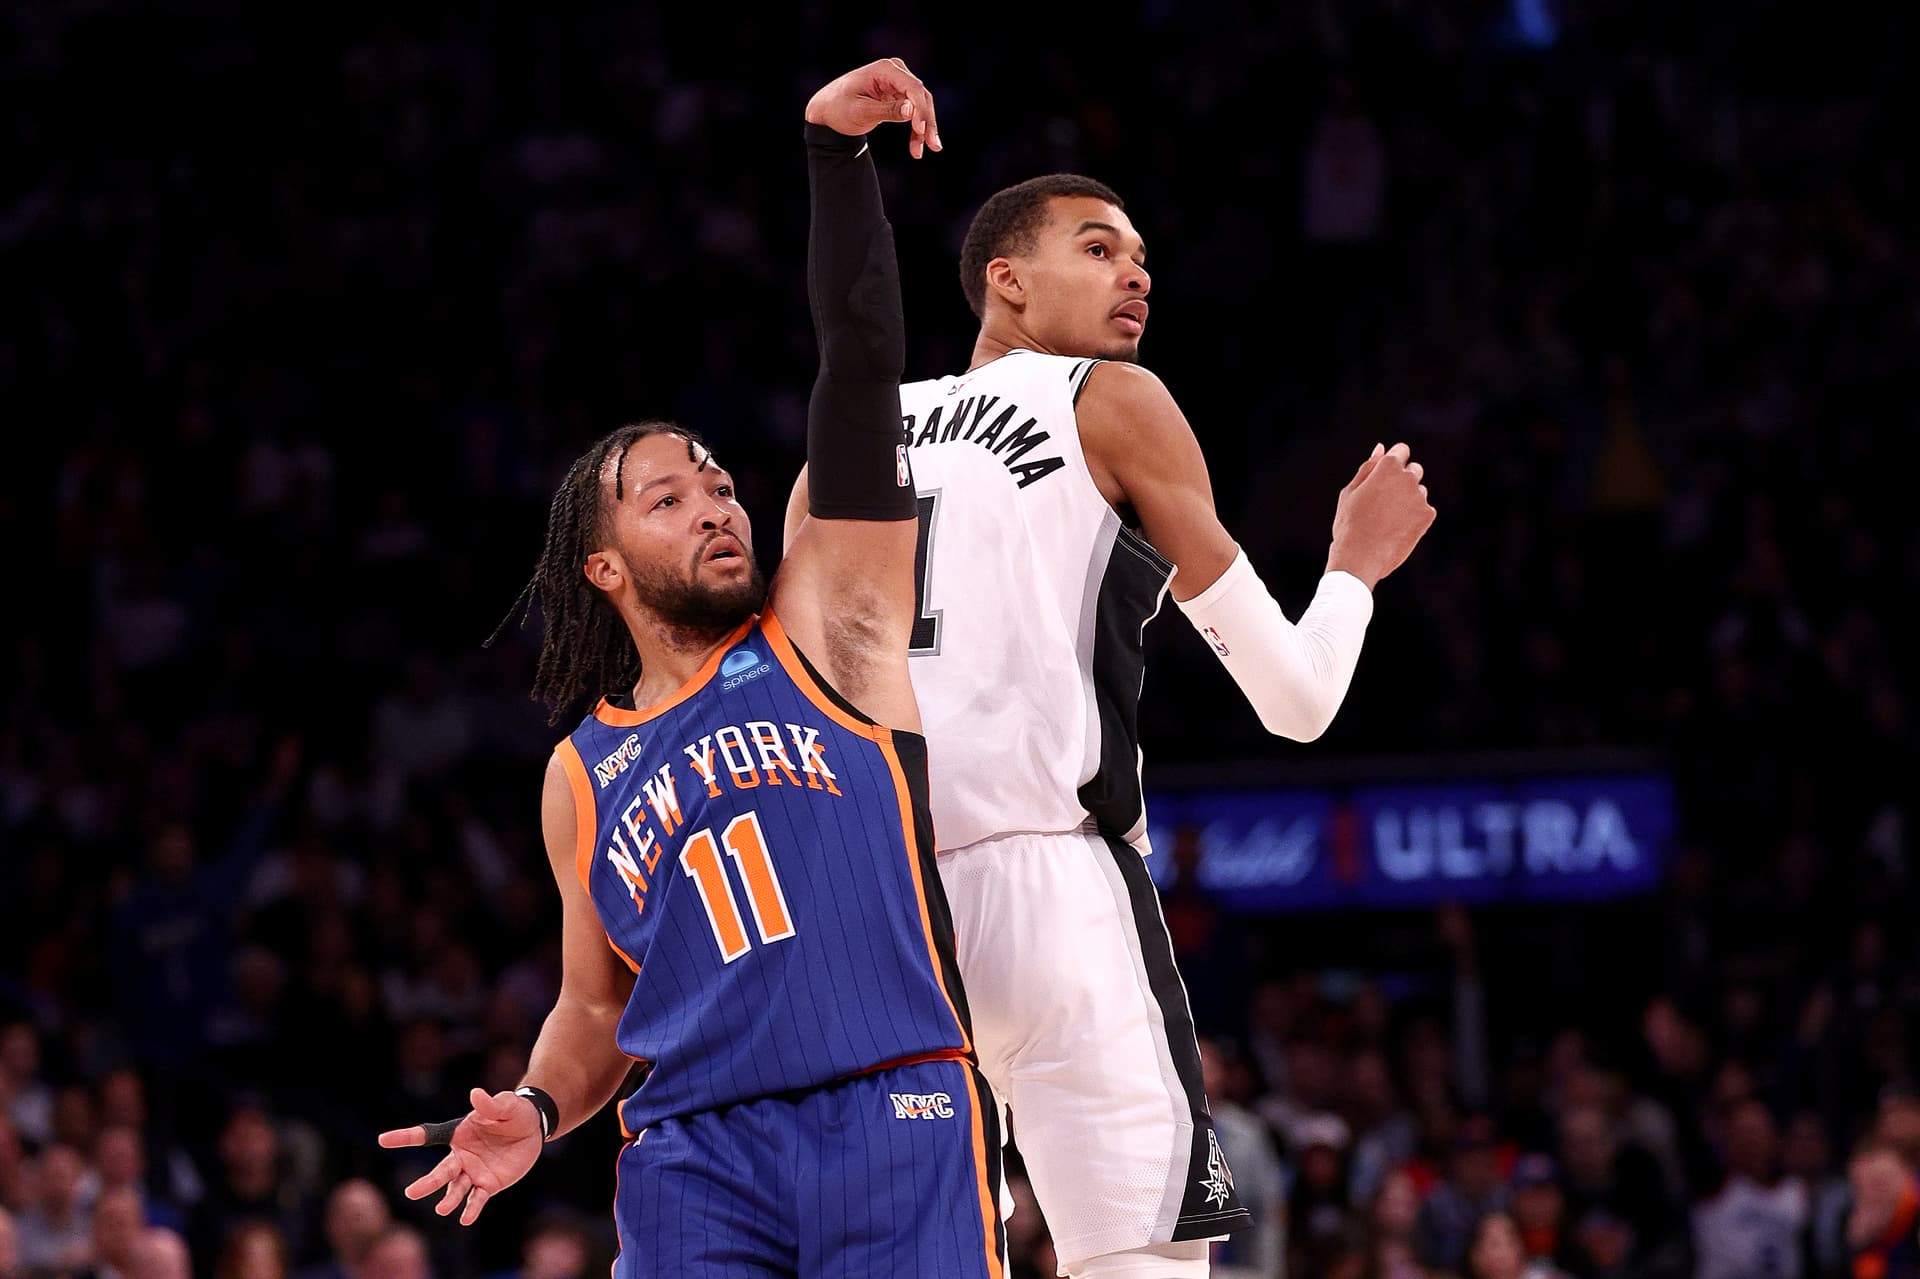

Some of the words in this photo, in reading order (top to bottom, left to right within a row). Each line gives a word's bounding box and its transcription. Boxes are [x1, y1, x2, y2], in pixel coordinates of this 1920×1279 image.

[723, 664, 770, 690] sphere
[593, 733, 642, 789] NYC
[606, 762, 684, 914] NEW
[684, 720, 842, 797] YORK
[1374, 801, 1637, 881] ULTRA
[679, 810, 796, 964] 11
[889, 1092, 955, 1120] NYC
